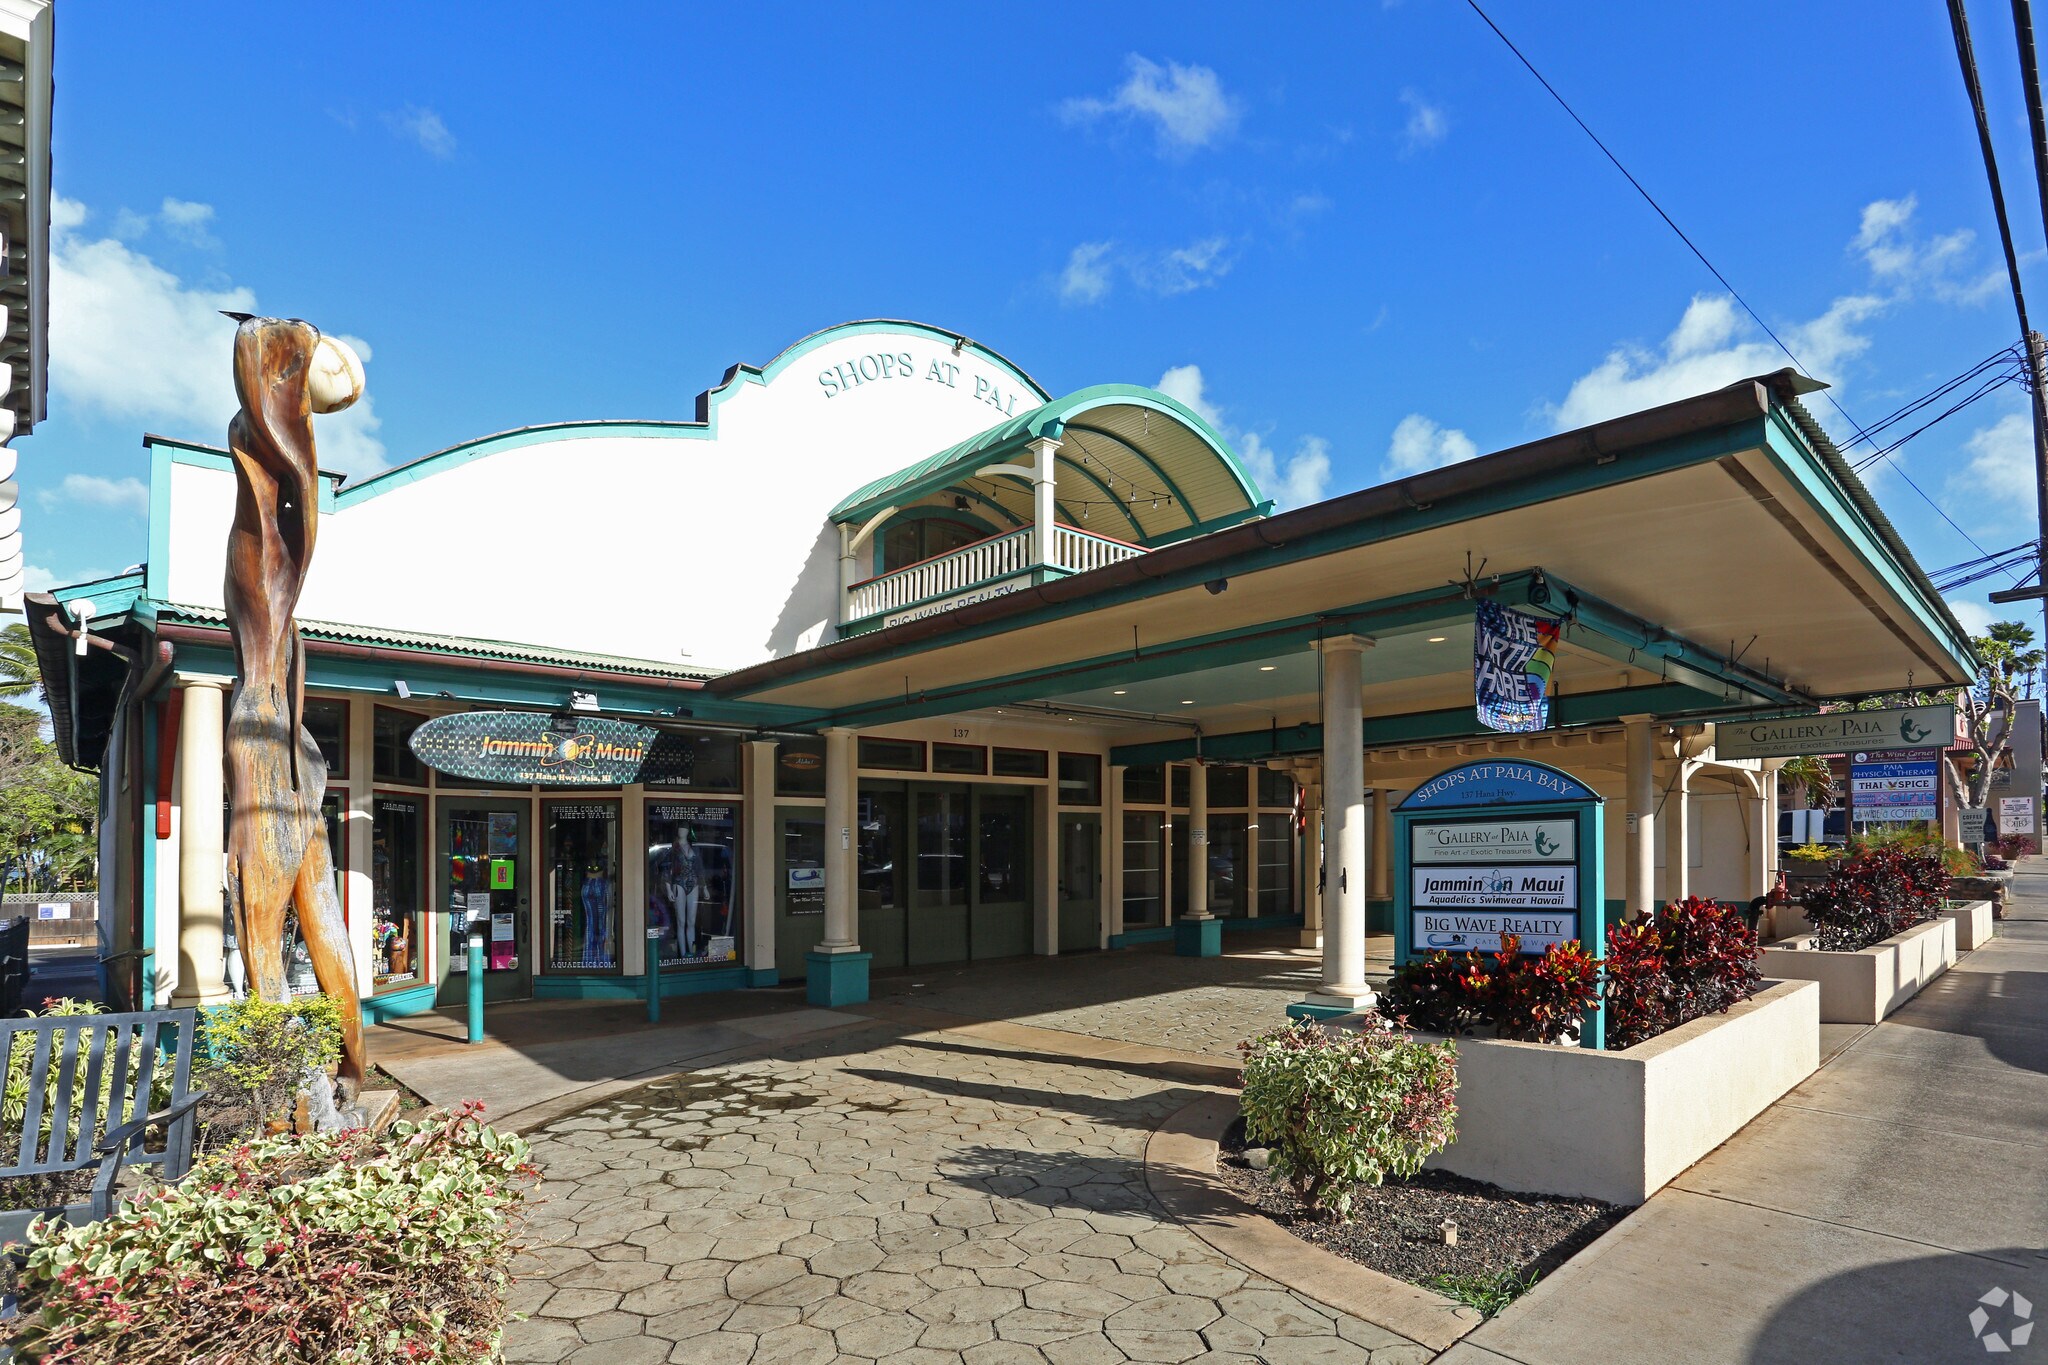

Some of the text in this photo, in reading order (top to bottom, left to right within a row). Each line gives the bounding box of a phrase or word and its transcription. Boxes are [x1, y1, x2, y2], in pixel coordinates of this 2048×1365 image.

[818, 352, 1018, 418] SHOPS AT PAI
[1501, 611, 1538, 644] THE
[953, 728, 969, 738] 137
[1735, 719, 1883, 743] The GALLERY at PAIA
[478, 735, 554, 759] Jammin
[595, 741, 644, 762] Maui
[1750, 744, 1770, 752] Fine
[1774, 743, 1787, 751] Art
[1800, 740, 1830, 749] Exotic
[1834, 738, 1885, 747] Treasures
[520, 772, 534, 780] 137
[536, 772, 557, 781] Hana
[1852, 768, 1936, 778] PHYSICAL THERAPY
[676, 776, 690, 785] Maui
[1417, 766, 1574, 802] SHOPS AT PAIA BAY
[1859, 780, 1929, 789] THAI SPICE
[1461, 791, 1473, 799] 137
[1475, 790, 1495, 798] Hana
[1889, 791, 1936, 803] GIFTS
[1920, 808, 1935, 817] BAR
[1437, 829, 1491, 845] GALLERY
[1501, 827, 1529, 843] PAIA
[1423, 875, 1483, 894] Jammin
[1521, 875, 1565, 892] Maui
[1429, 895, 1564, 906] Aquadelics Swimwear Hawaii
[1424, 916, 1563, 934] BIG WAVE REALTY
